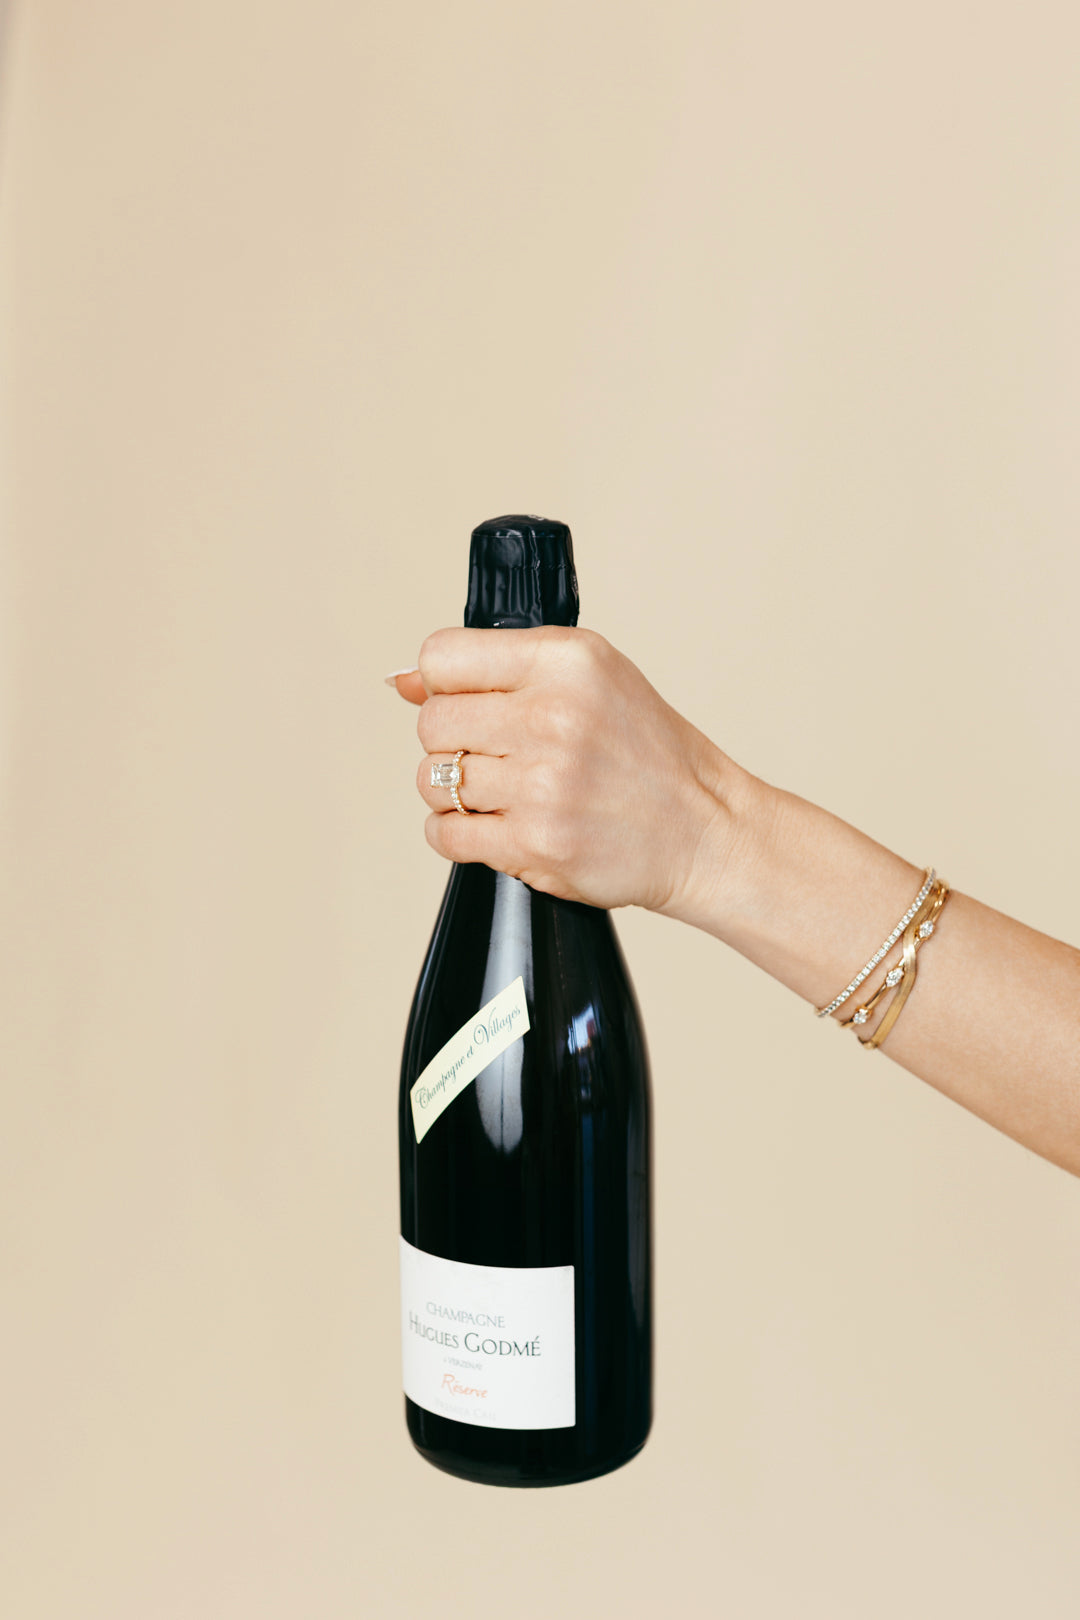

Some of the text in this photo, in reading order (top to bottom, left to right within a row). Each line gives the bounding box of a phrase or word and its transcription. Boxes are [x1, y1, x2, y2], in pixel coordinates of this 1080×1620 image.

[415, 1008, 521, 1109] Champagne et Villages
[426, 1301, 506, 1328] CHAMPAGNE
[440, 1373, 488, 1398] Réserve
